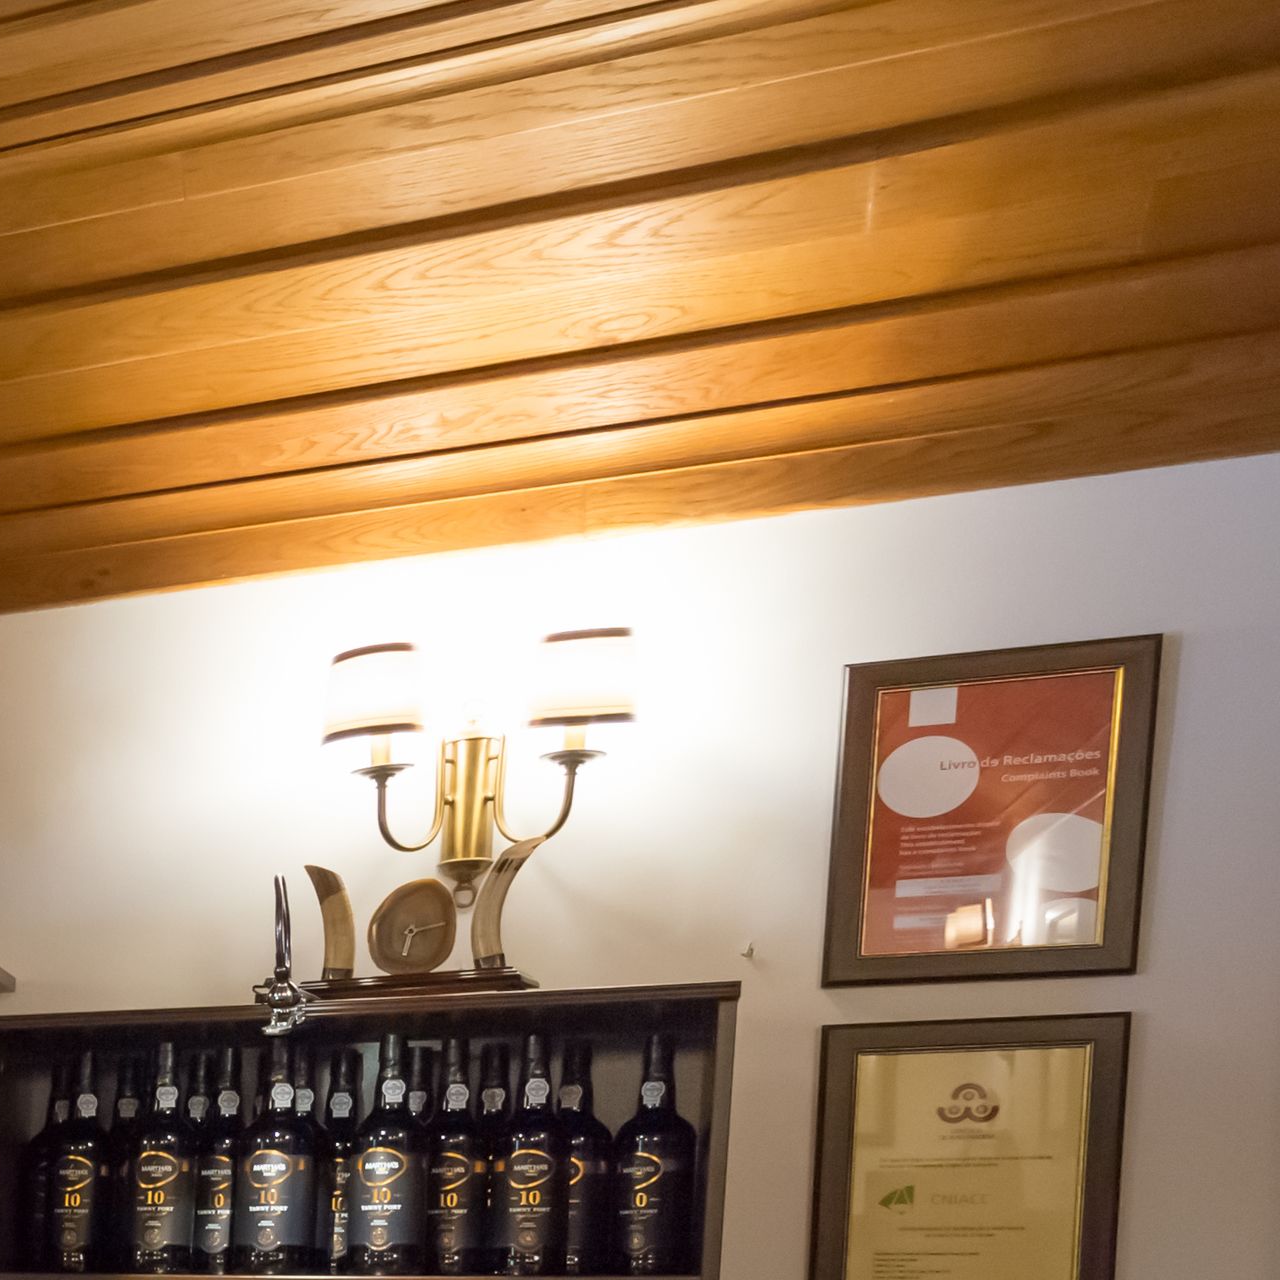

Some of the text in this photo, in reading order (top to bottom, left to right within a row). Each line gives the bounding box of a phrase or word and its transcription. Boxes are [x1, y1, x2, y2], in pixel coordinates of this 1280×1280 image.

[940, 750, 1102, 771] Livro de Reclamações
[1069, 767, 1100, 779] Book
[63, 1192, 81, 1208] 10
[146, 1190, 166, 1205] 10
[259, 1188, 278, 1205] 10
[372, 1187, 392, 1204] 10
[440, 1192, 458, 1208] 10
[520, 1190, 541, 1206] 10
